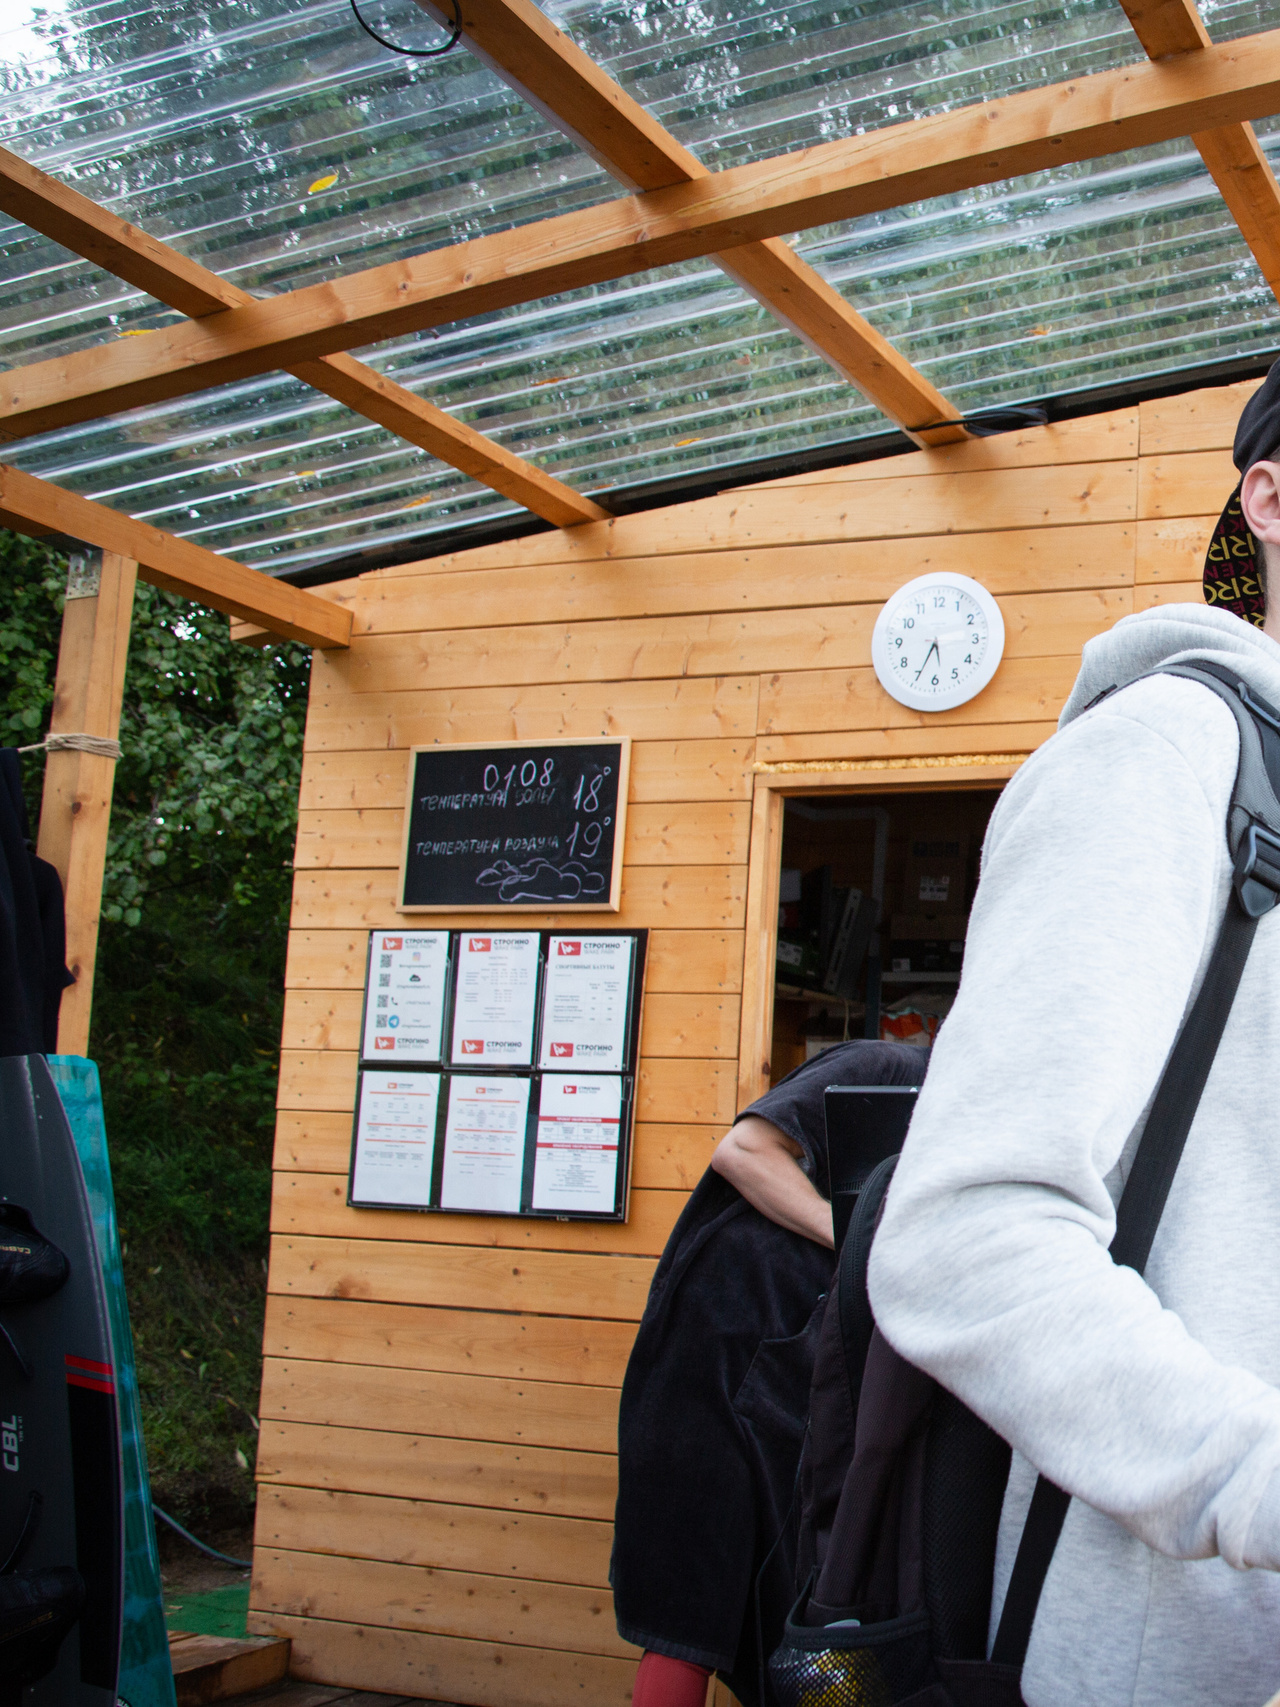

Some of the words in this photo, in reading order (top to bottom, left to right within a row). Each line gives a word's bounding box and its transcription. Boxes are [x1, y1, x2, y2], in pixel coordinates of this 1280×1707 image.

[933, 596, 946, 608] 12
[955, 601, 960, 612] 1
[916, 603, 925, 614] 11
[902, 617, 915, 629] 10
[966, 613, 975, 625] 2
[894, 637, 903, 649] 9
[971, 633, 980, 645] 3
[900, 656, 908, 668] 8
[964, 653, 972, 664] 4
[914, 670, 922, 682] 7
[951, 668, 959, 679] 5
[931, 674, 939, 686] 6
[1, 1414, 20, 1473] CBL
